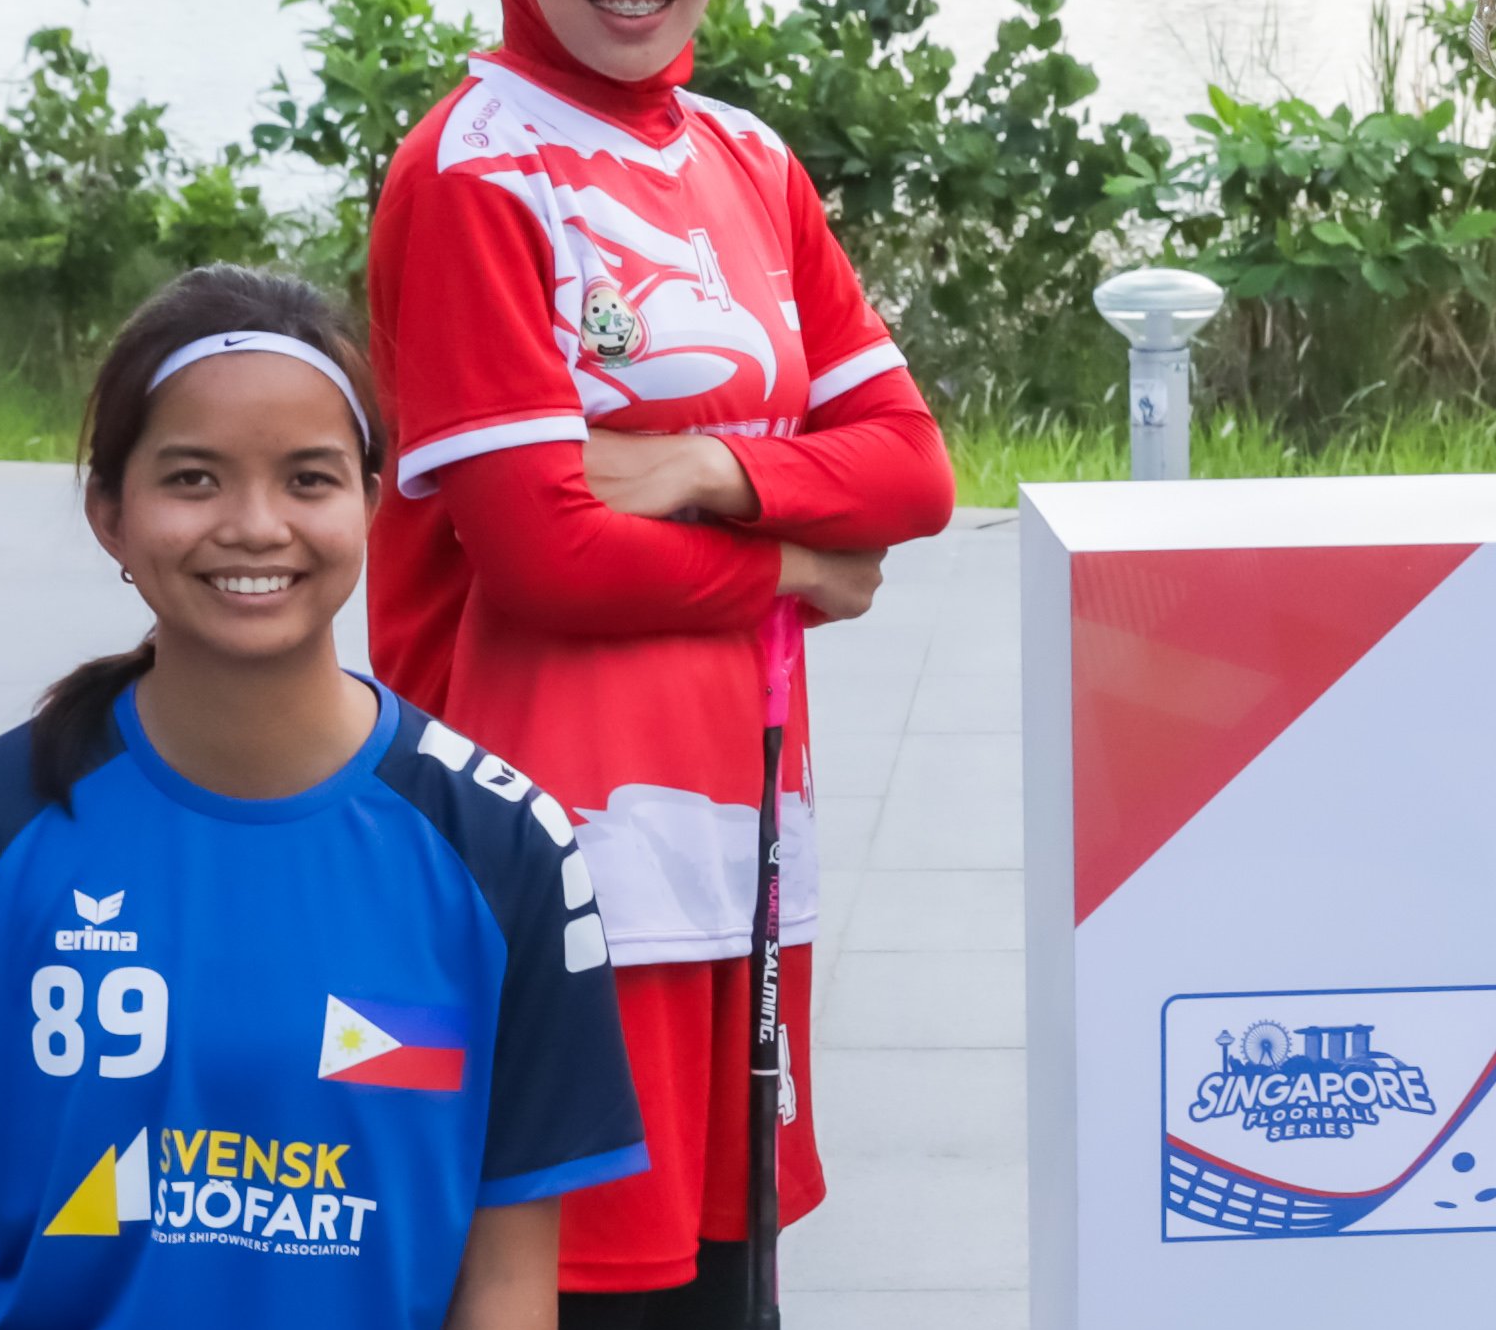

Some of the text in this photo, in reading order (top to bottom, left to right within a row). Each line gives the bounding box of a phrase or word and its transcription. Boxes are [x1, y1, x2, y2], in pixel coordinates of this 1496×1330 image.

[688, 228, 732, 313] 4
[55, 925, 138, 952] erima
[31, 965, 169, 1079] 89
[1191, 1070, 1434, 1119] SINGAPORE
[1246, 1106, 1376, 1128] FLOORBALL
[1269, 1123, 1352, 1140] SERIES
[159, 1127, 352, 1189] SVENSK
[153, 1177, 378, 1242] SJÖFART
[274, 1242, 360, 1257] ASSOCIATION
